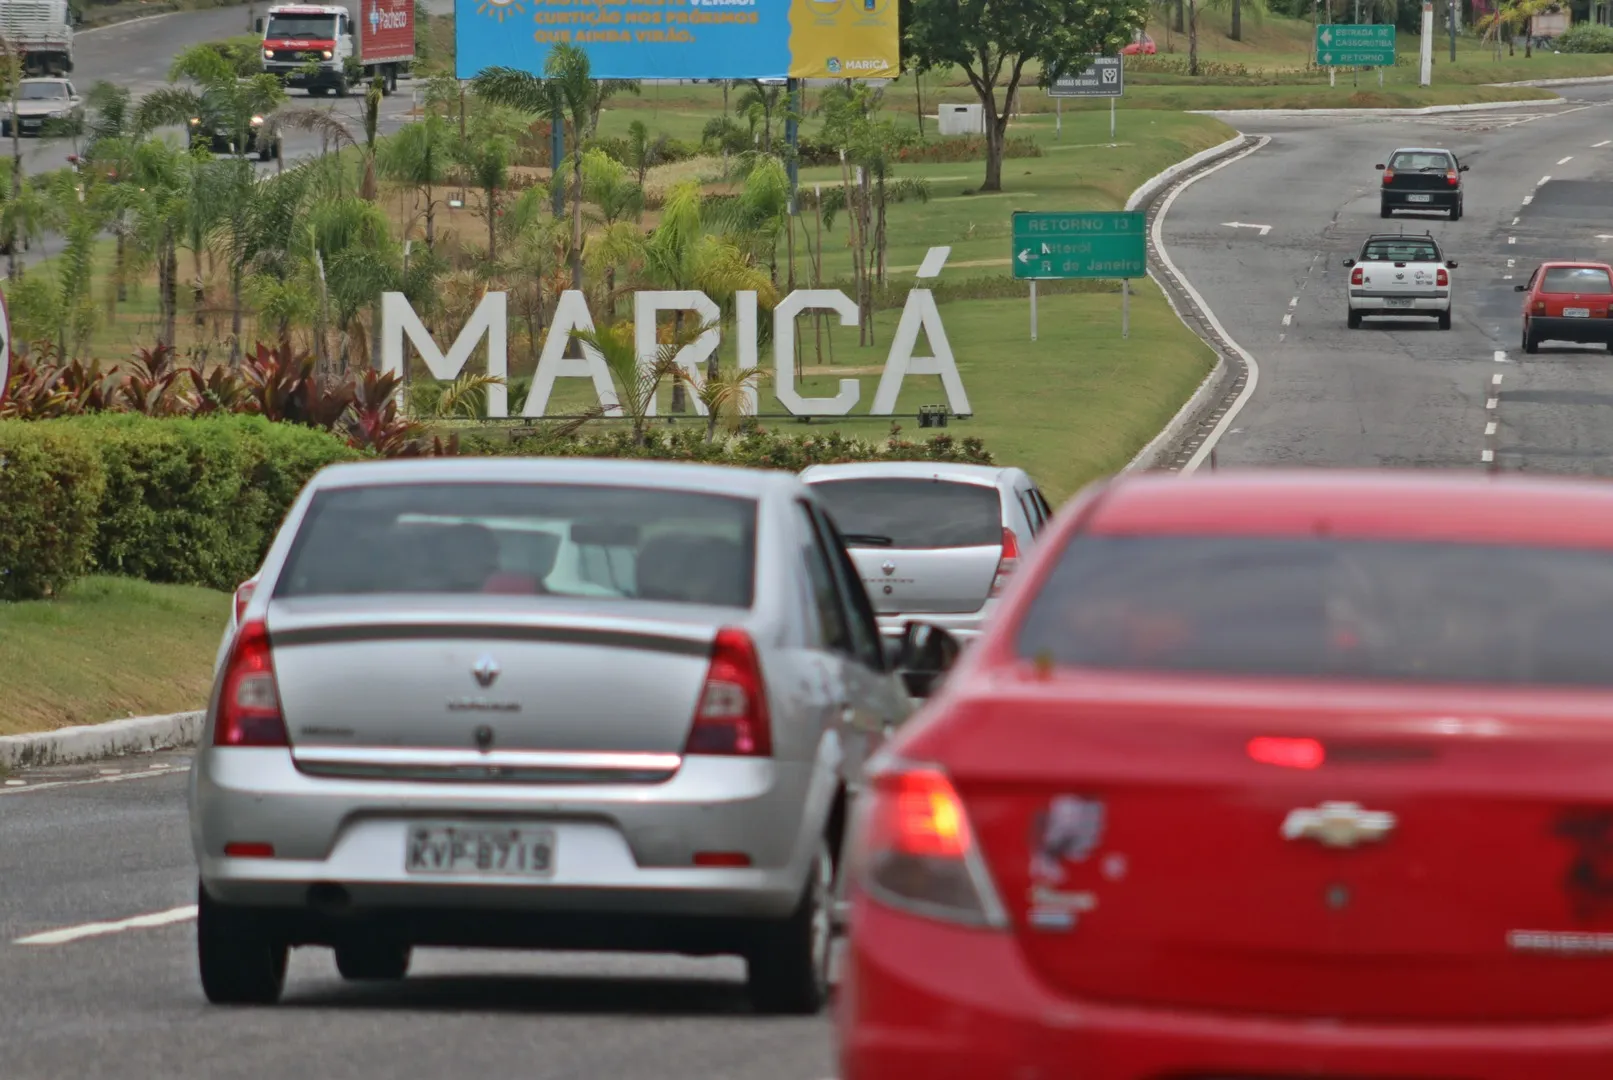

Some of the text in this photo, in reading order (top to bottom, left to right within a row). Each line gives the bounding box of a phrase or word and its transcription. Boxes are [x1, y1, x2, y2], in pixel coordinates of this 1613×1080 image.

[534, 8, 759, 26] CURTIÇÃO NOS PRÓXIMOS
[534, 29, 571, 43] QUE
[575, 29, 632, 42] AINDA
[1335, 28, 1389, 37] ESTRADA DE
[1340, 54, 1385, 62] RETORNO
[1028, 218, 1129, 231] RETORNO 13
[1062, 259, 1080, 272] de
[1086, 259, 1141, 272] Janeiro
[380, 246, 972, 418] MARICÁ
